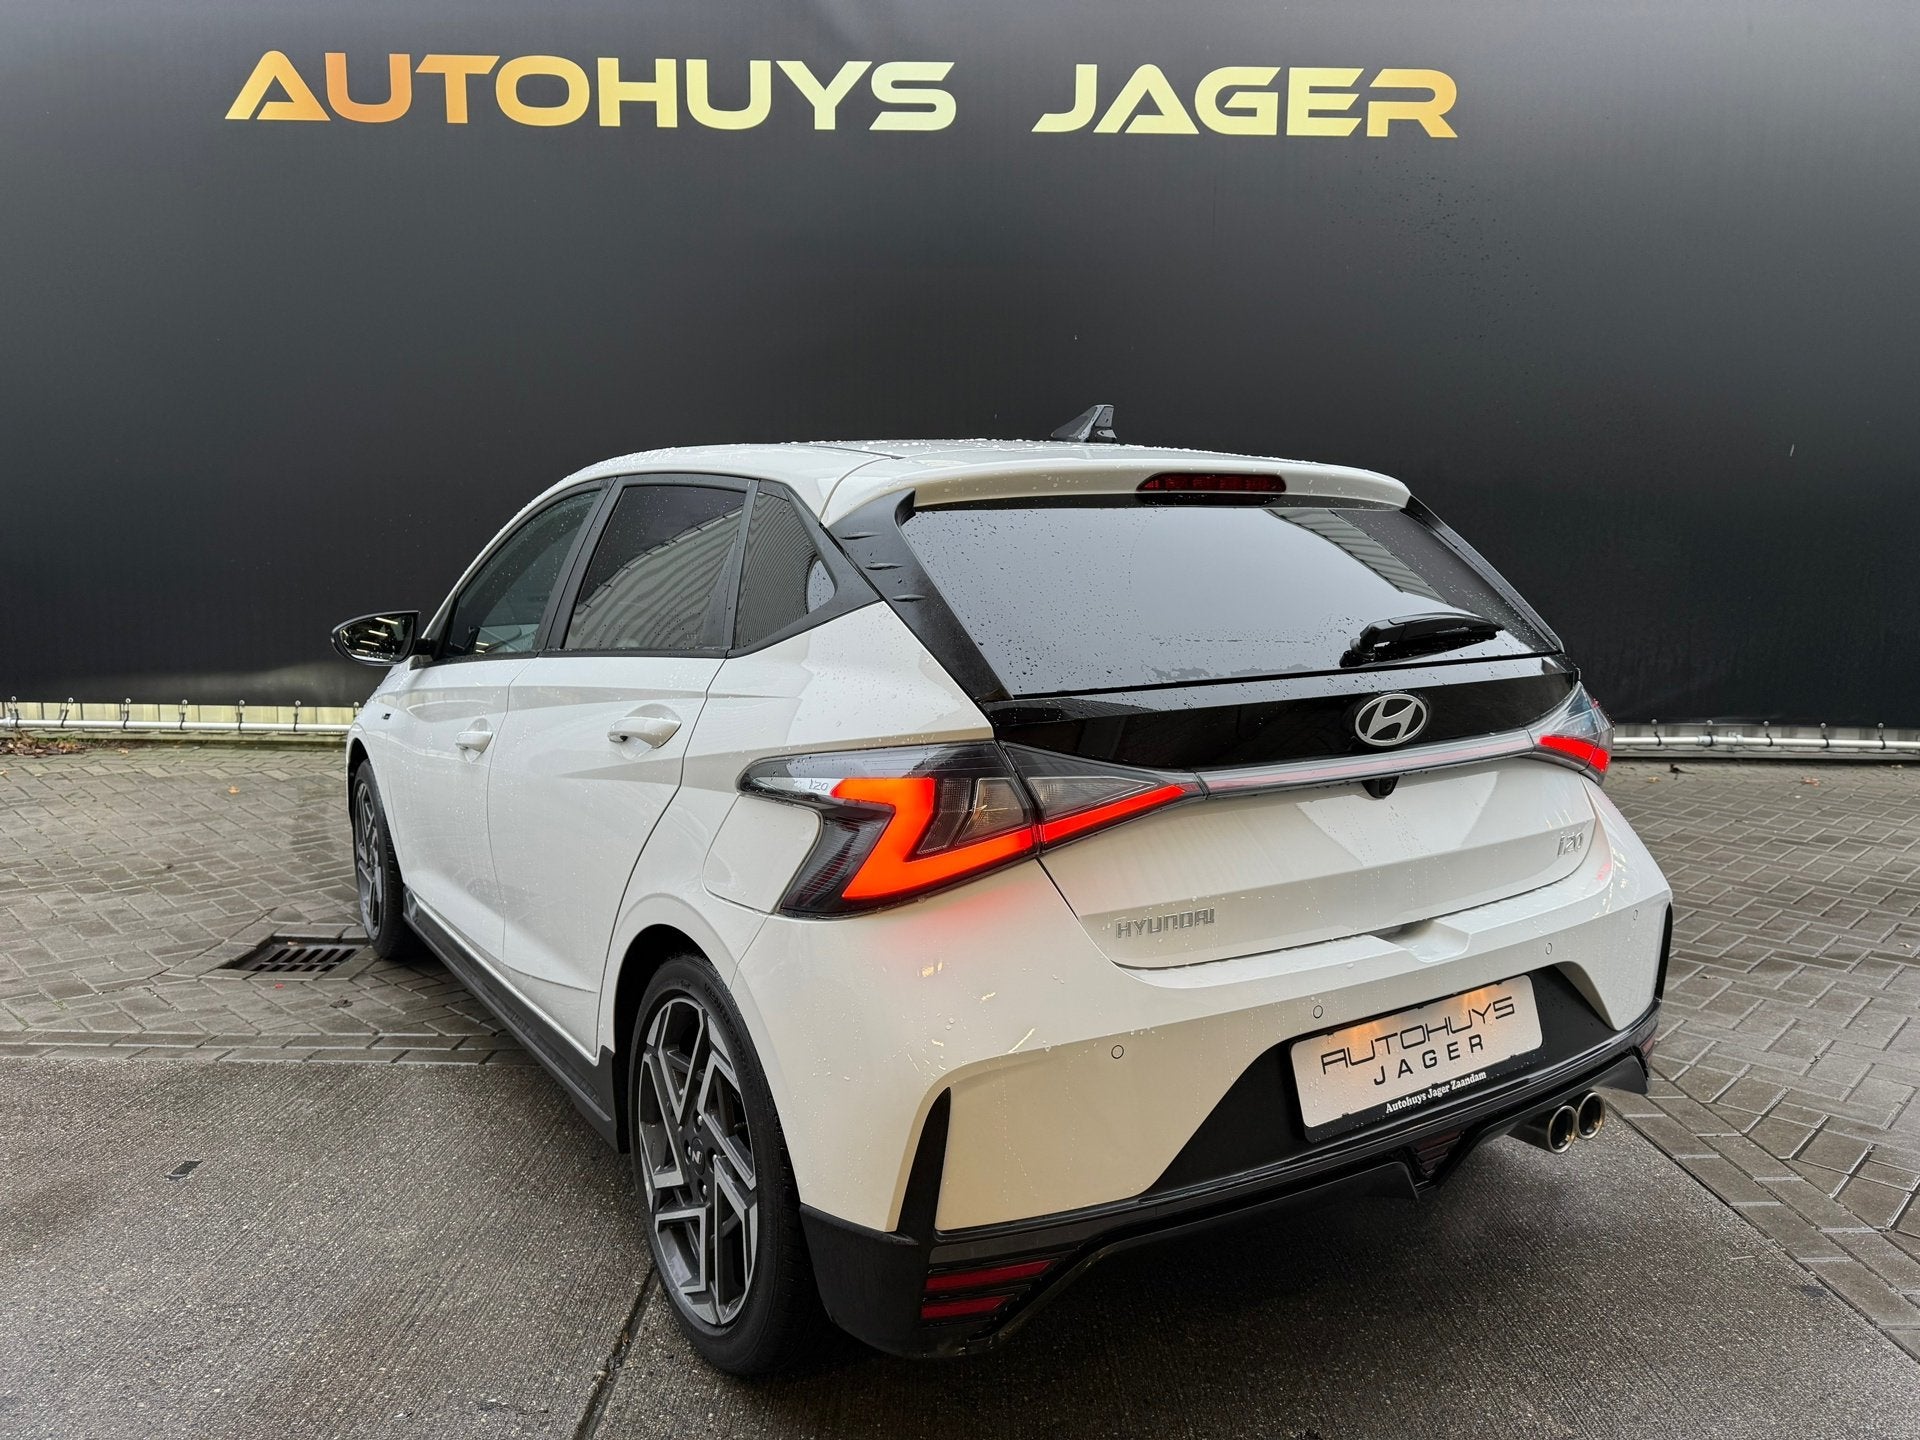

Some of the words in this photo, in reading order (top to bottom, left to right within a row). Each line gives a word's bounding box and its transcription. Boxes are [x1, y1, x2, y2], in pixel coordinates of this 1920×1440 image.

[225, 50, 957, 132] AUTOHUYS
[1031, 63, 1458, 138] JAGER
[1115, 906, 1215, 939] HYUNDAI
[1320, 996, 1515, 1075] AUTOHUYS
[1373, 1034, 1484, 1086] JAGER
[1385, 1093, 1427, 1113] Autohuys
[1427, 1084, 1450, 1098] Jager
[1451, 1071, 1487, 1090] Zaandam
